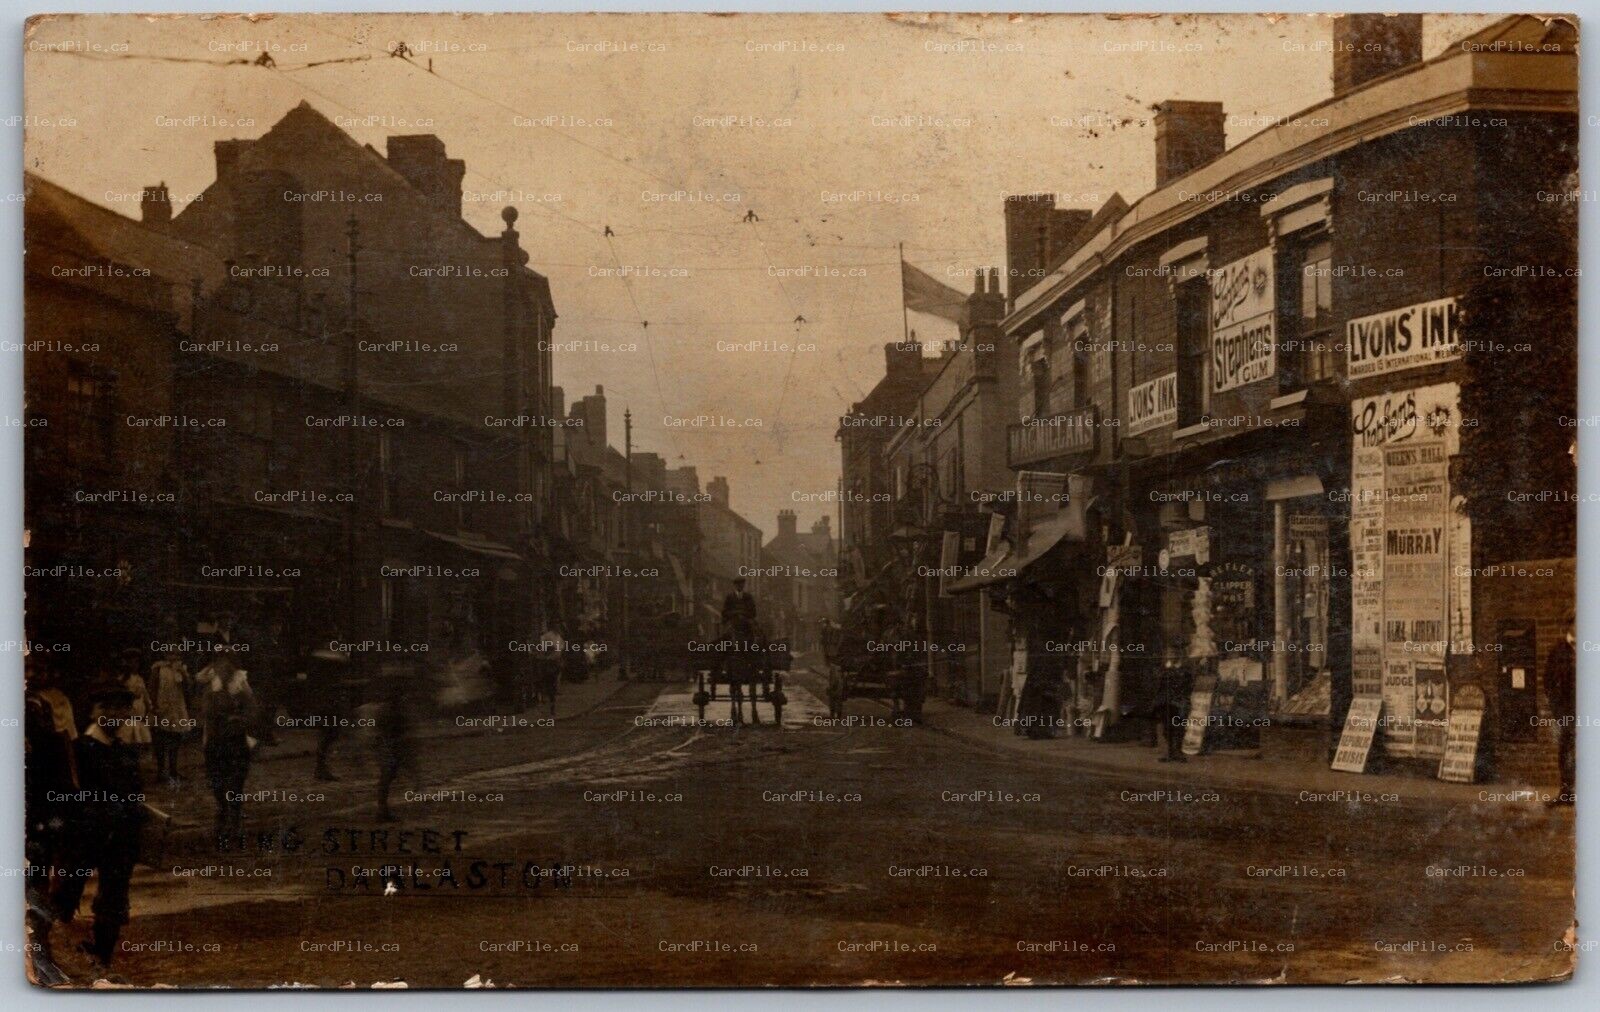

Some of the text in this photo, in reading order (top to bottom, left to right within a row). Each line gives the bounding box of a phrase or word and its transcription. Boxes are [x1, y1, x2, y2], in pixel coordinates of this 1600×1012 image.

[1349, 308, 1416, 362] LYONS'
[1243, 359, 1268, 382] GUM
[1158, 376, 1177, 413] INK
[1387, 485, 1443, 498] DARLASTON
[1387, 527, 1442, 556] MURRAY
[1385, 676, 1414, 687] JUDGE
[1336, 750, 1365, 765] CRISIS
